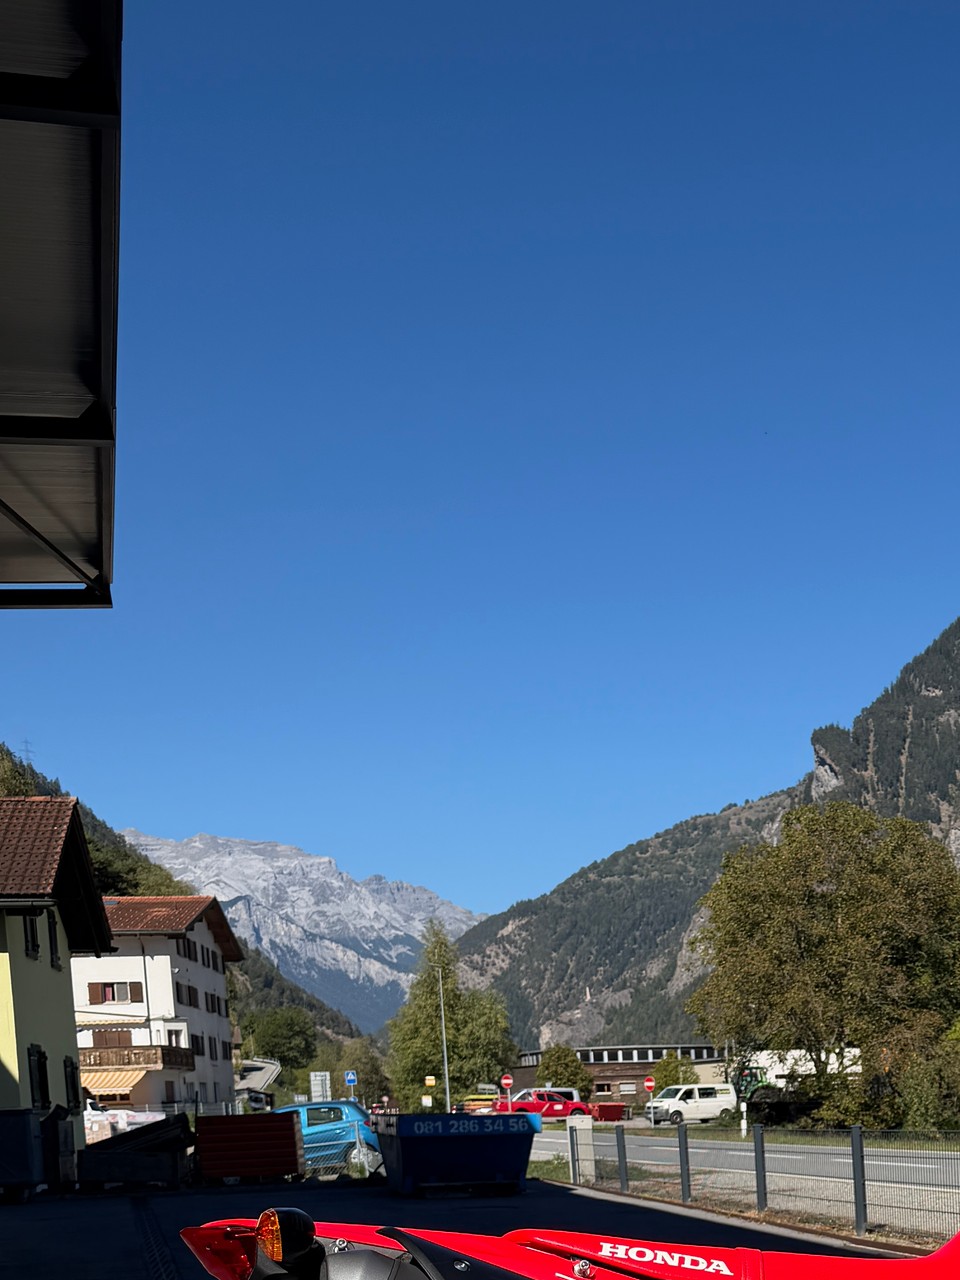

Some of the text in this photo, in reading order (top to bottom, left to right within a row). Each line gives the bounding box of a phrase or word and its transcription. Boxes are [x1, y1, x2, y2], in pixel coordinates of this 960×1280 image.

[414, 1118, 529, 1134] 081 286 34 56
[598, 1242, 734, 1276] HONDA
